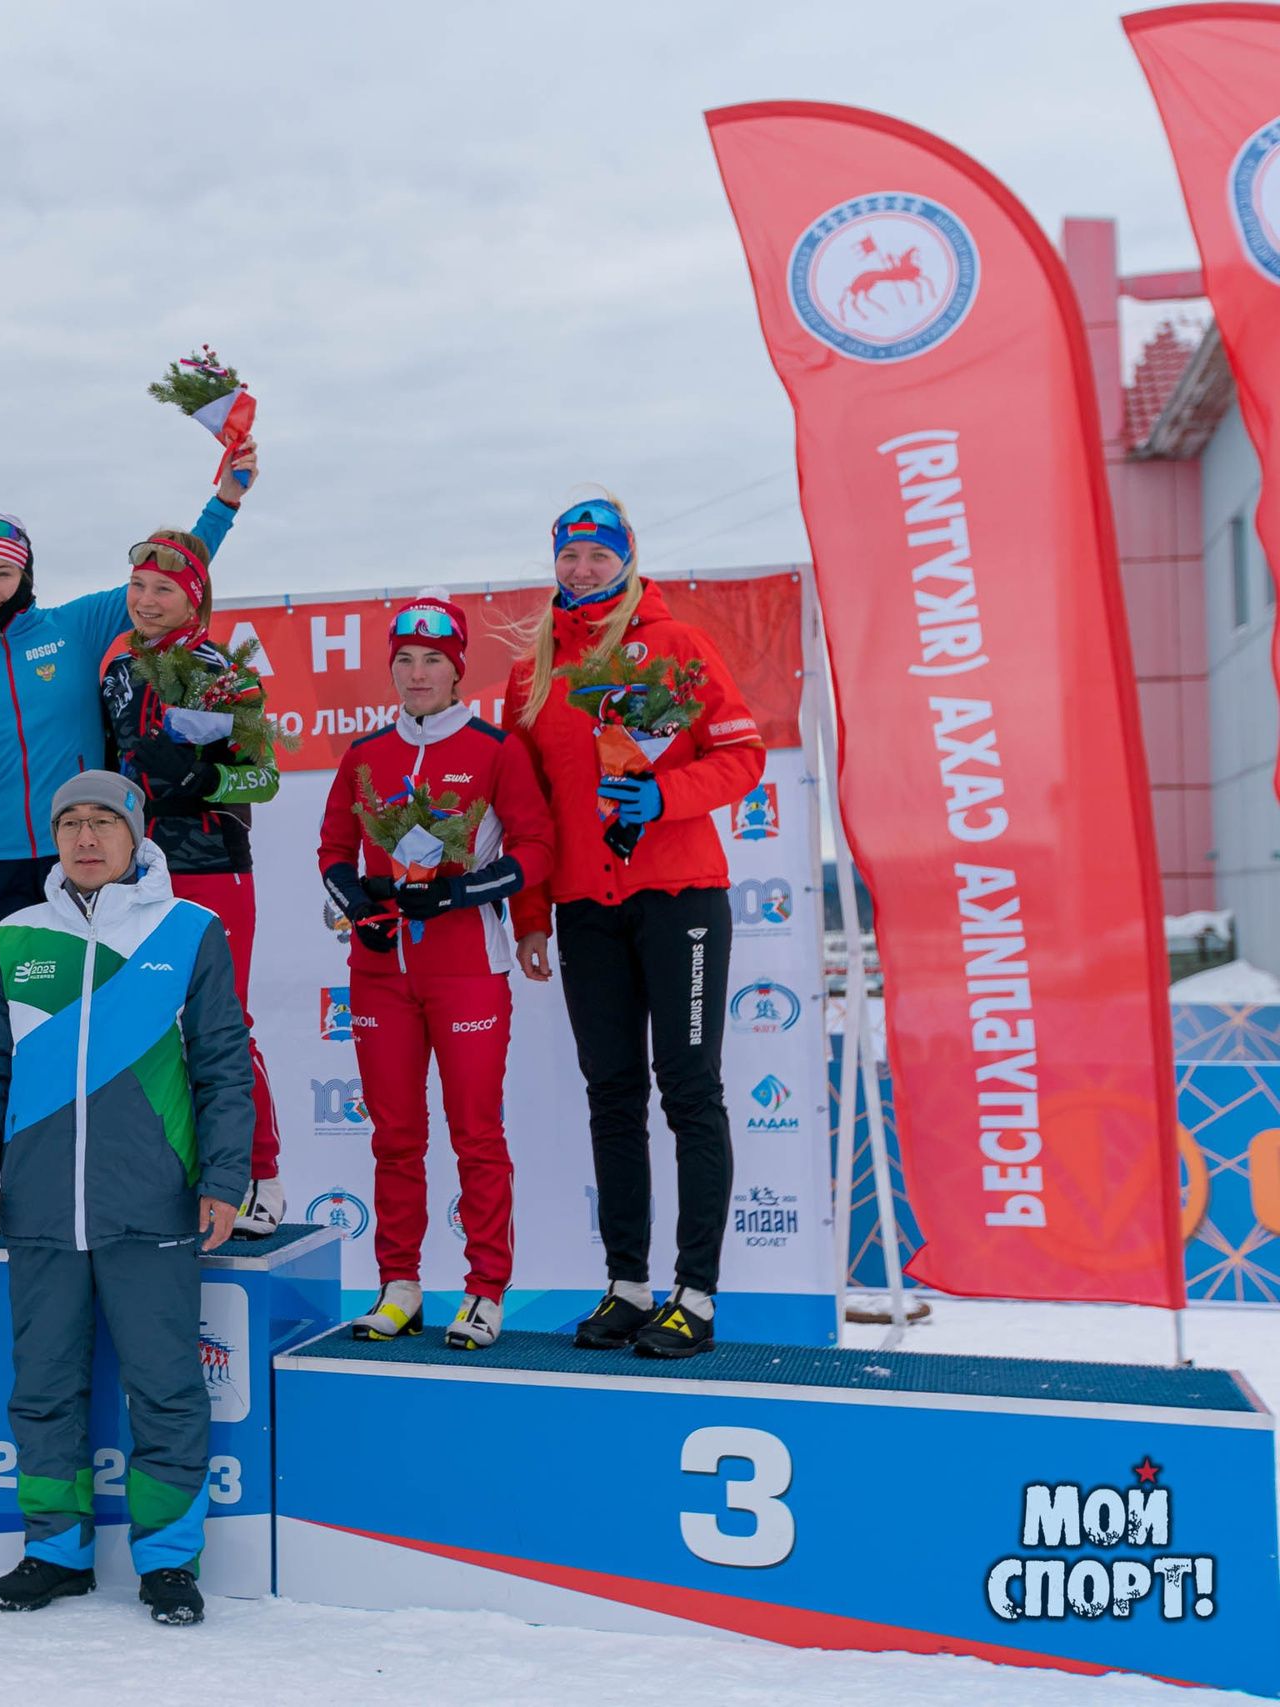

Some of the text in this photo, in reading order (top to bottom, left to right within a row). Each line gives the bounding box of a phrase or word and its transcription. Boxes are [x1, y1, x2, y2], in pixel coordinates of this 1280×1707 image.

[25, 642, 58, 661] BOSCO
[689, 943, 705, 1046] BELARUS TRACTORS
[452, 1018, 493, 1032] BOSCO
[747, 1117, 799, 1128] АЛДАН
[680, 1426, 795, 1568] 3
